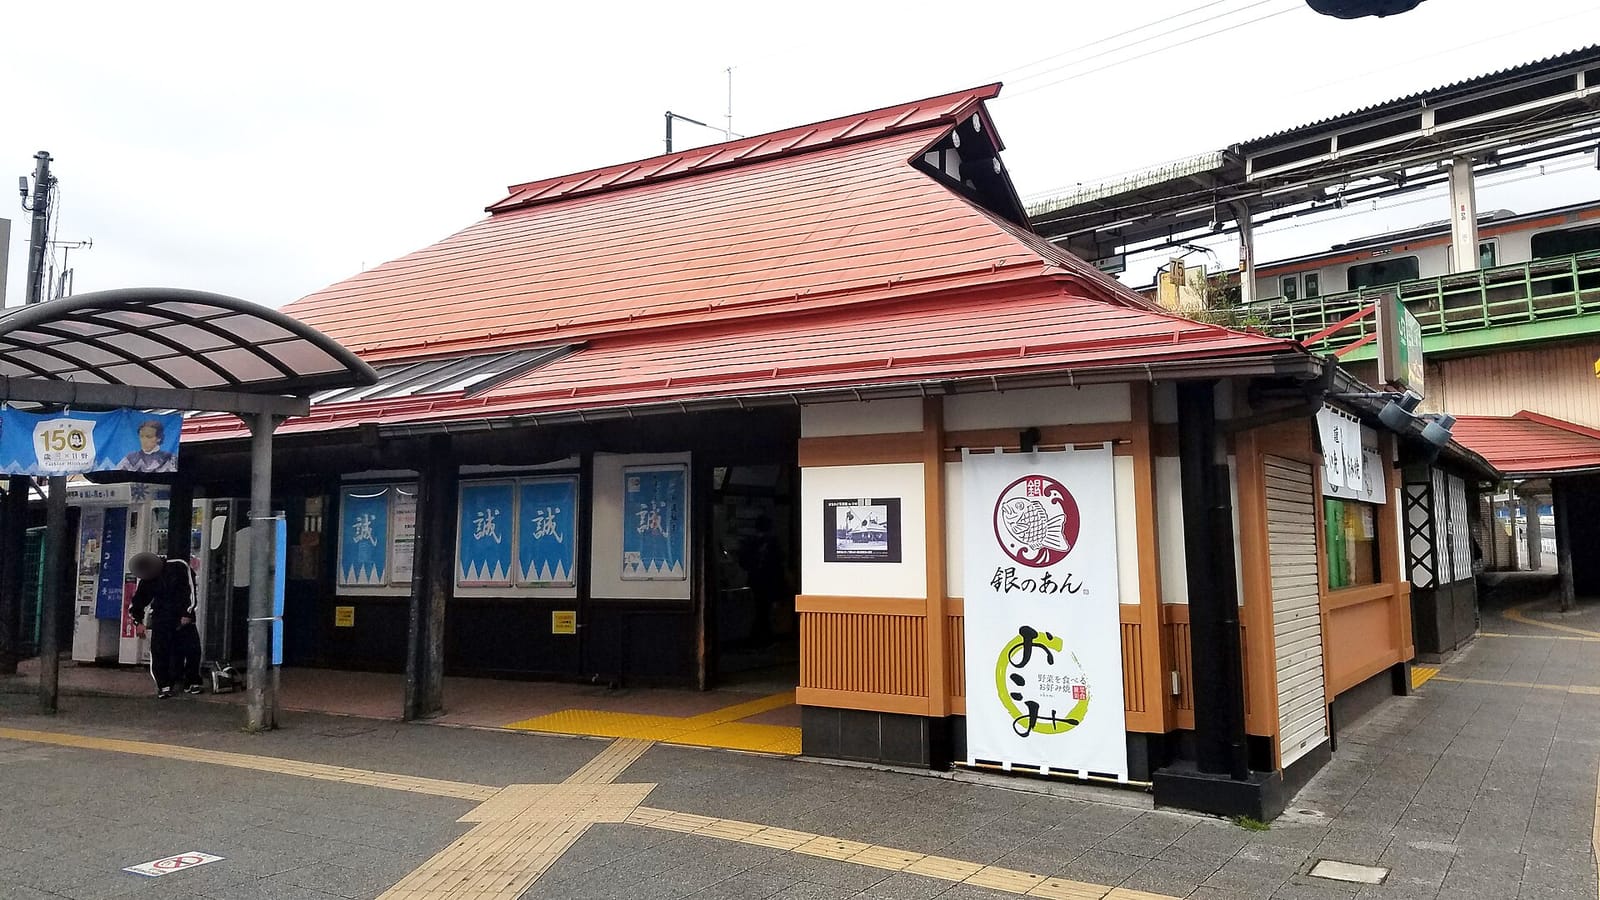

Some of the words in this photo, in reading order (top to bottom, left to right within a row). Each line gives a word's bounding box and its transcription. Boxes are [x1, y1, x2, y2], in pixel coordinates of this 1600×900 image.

[40, 429, 87, 452] 150
[352, 513, 378, 547] 誠
[473, 508, 502, 545] 誠
[532, 506, 564, 544] 誠
[990, 566, 1083, 595] 銀のあん
[1037, 673, 1088, 685] 野菜を食べる
